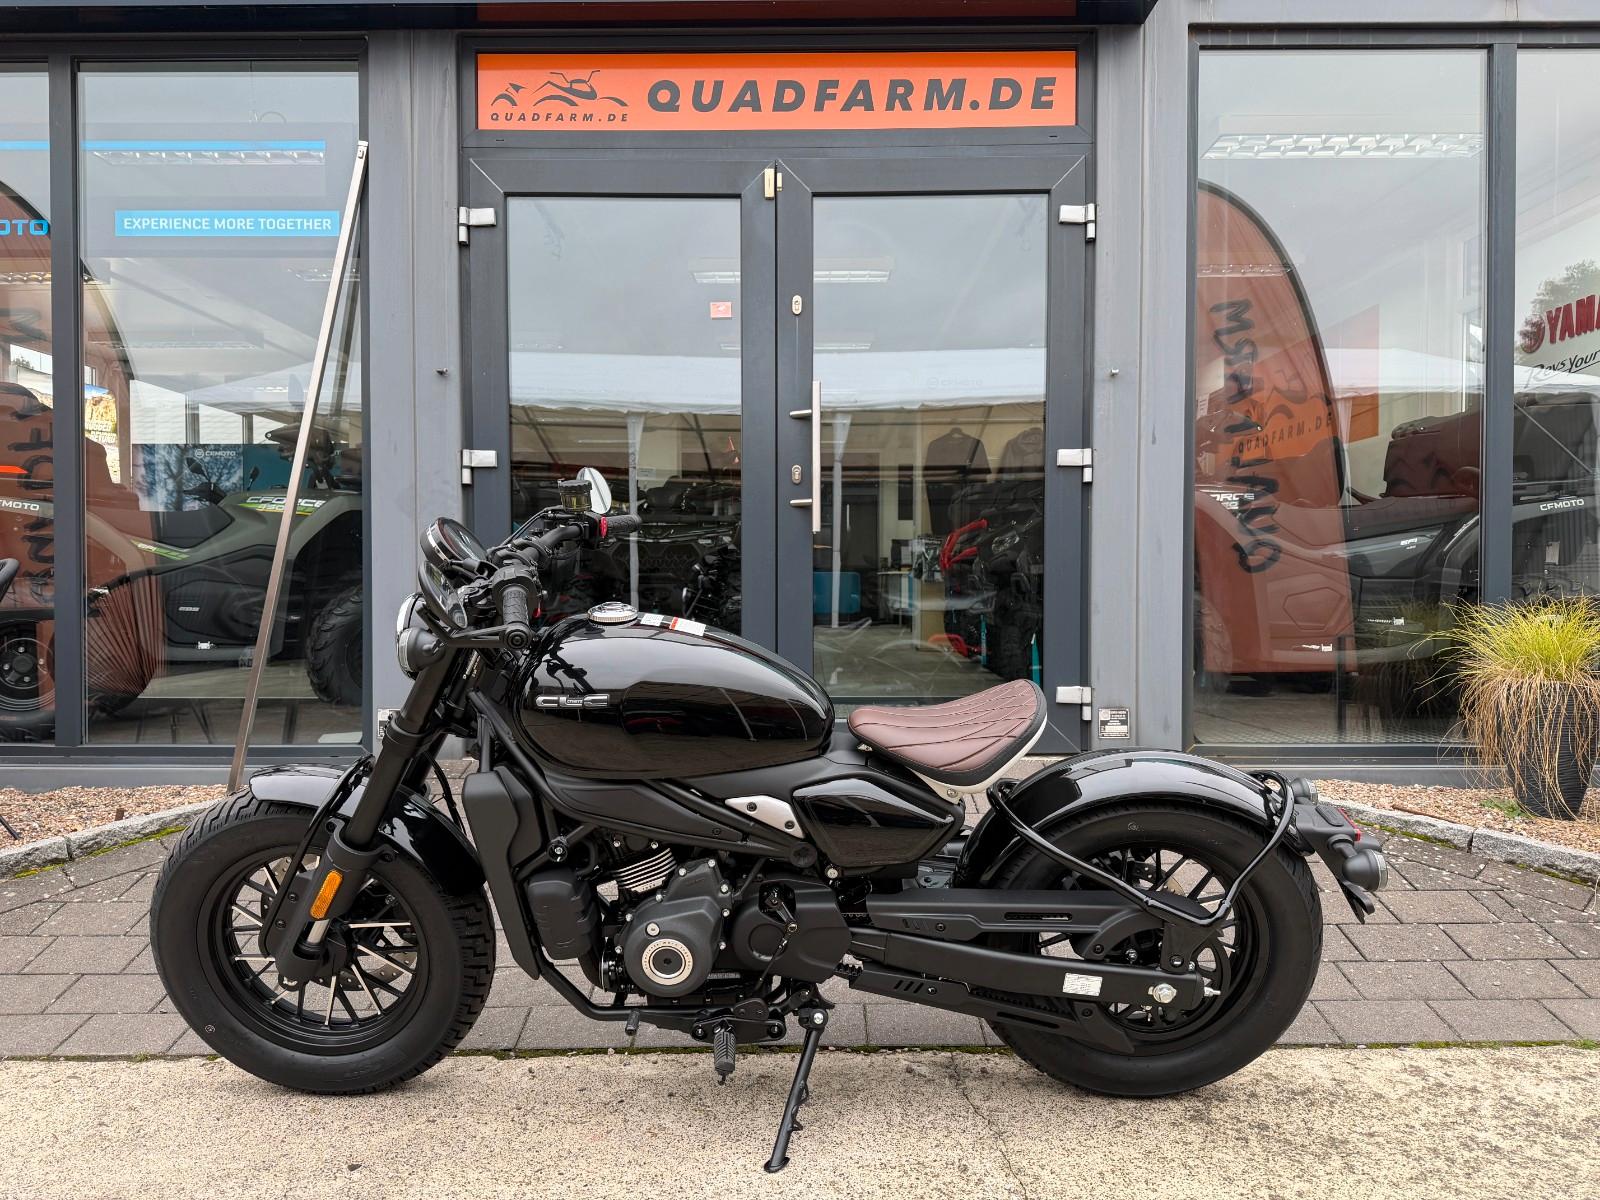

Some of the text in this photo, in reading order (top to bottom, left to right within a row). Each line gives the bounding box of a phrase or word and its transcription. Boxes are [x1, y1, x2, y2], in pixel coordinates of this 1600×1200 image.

[647, 76, 1057, 114] QUADFARM.DE
[490, 112, 629, 123] QUADFARM.DE
[123, 217, 332, 231] EXPERIENCE MORE TOGETHER
[246, 496, 327, 508] CFOCE
[1540, 498, 1585, 511] CFMOTO
